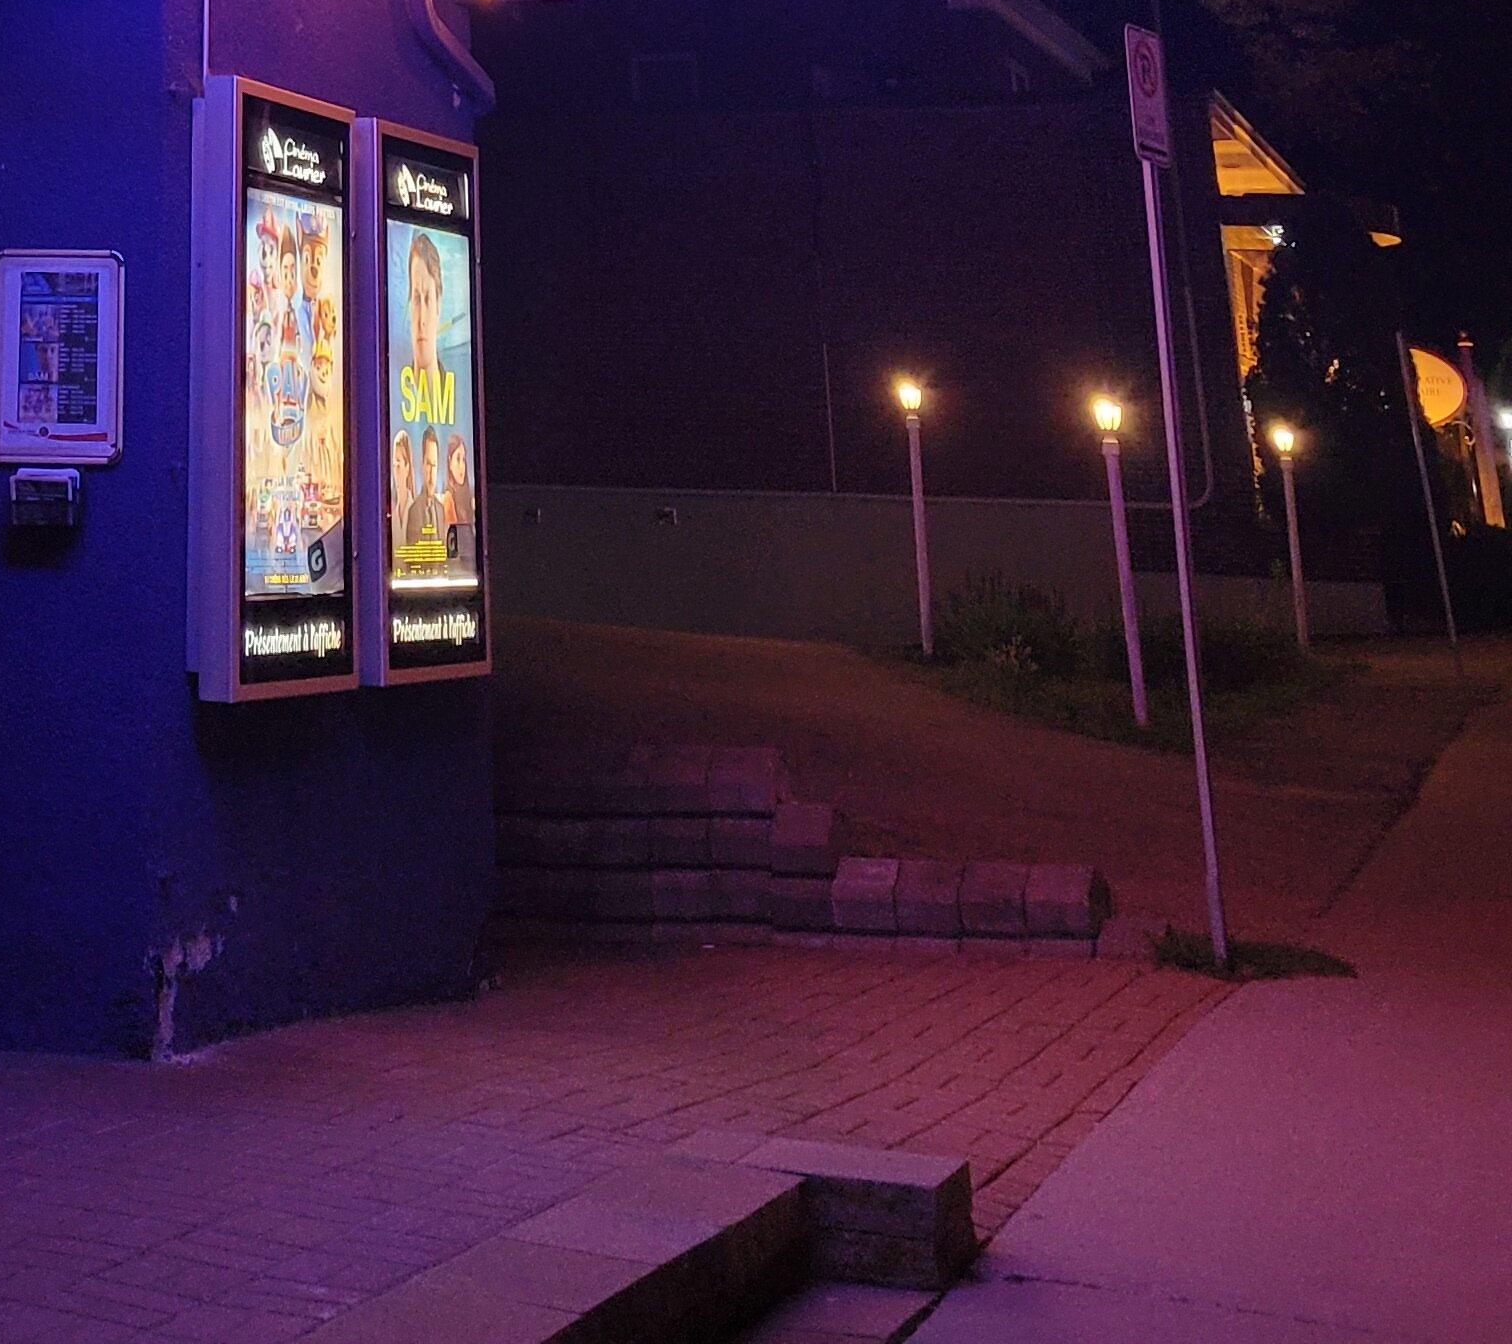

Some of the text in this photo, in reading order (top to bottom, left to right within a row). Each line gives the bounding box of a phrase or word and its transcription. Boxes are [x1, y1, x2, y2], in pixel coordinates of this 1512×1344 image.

[400, 366, 455, 426] SAM
[310, 548, 325, 572] G
[245, 620, 342, 658] Présentement à l'affiche
